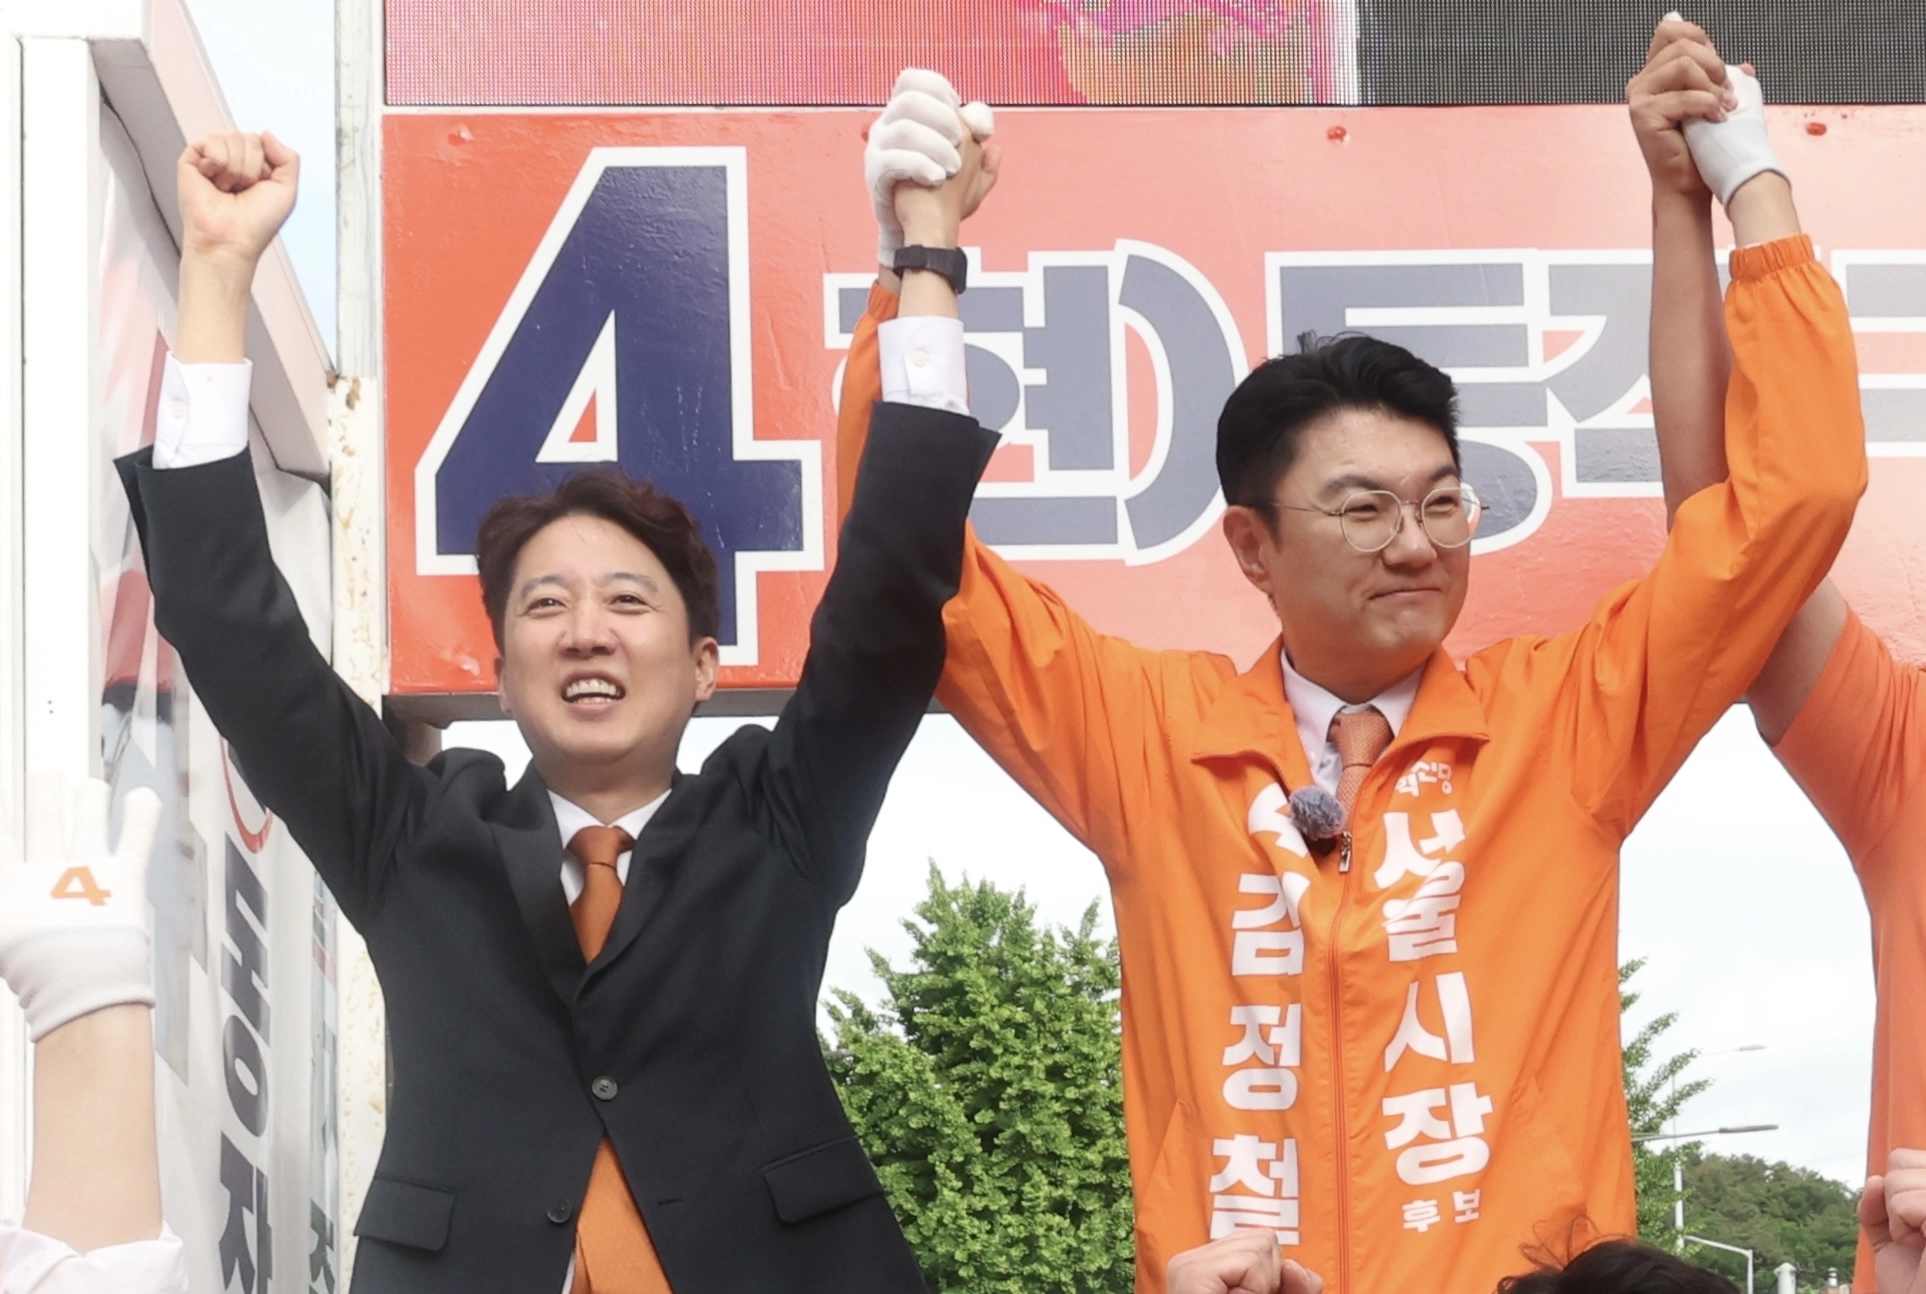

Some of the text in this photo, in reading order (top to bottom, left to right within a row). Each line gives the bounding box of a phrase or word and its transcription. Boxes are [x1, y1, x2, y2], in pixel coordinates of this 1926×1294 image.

[414, 146, 823, 666] 4
[50, 865, 113, 906] 4
[1208, 871, 1311, 1246] 김정철
[1373, 808, 1494, 1186] 서울시장
[1402, 1188, 1482, 1232] 후보
